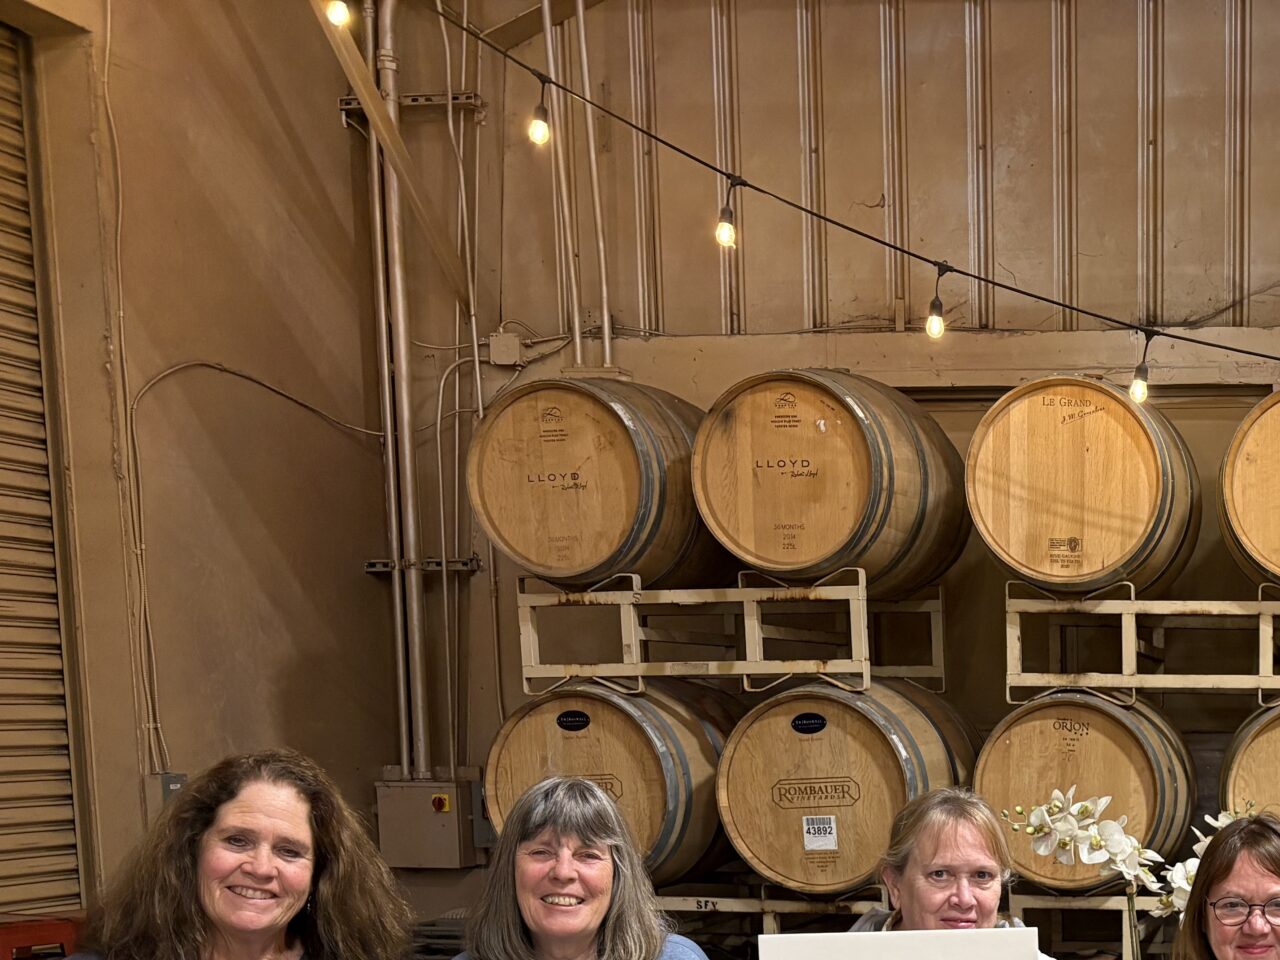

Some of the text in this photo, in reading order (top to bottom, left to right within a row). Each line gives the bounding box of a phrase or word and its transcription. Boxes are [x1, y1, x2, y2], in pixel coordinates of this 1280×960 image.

[1042, 396, 1092, 407] LE GRAND
[756, 459, 810, 468] LLOYD
[527, 472, 580, 483] LLOYD
[1052, 719, 1090, 732] ORION
[777, 783, 857, 804] ROMBAUER
[805, 826, 834, 836] 43892
